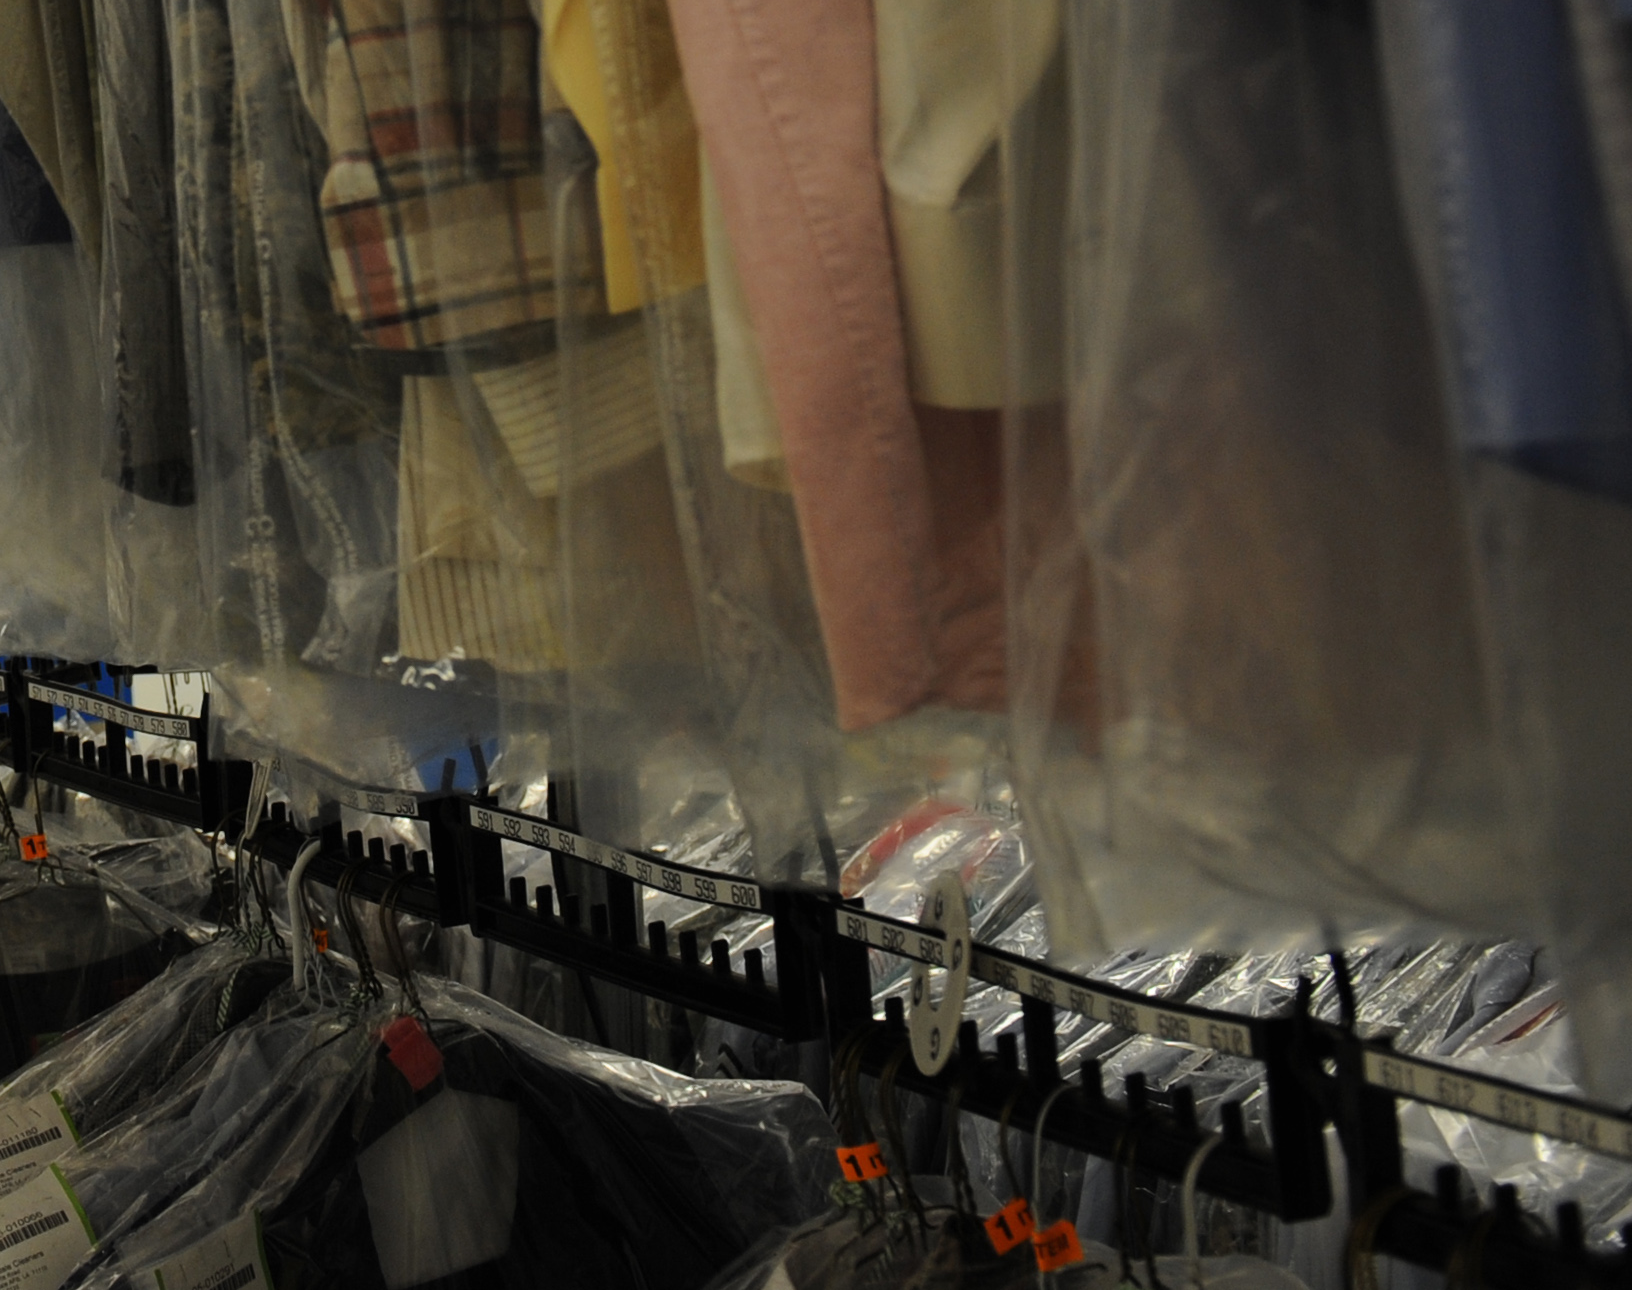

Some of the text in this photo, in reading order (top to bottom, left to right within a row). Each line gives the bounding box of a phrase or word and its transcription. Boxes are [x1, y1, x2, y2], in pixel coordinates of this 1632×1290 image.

[47, 690, 58, 705] 572
[63, 694, 74, 709] 573
[150, 718, 166, 734] 579
[172, 721, 187, 736] 580
[26, 838, 37, 854] 1
[478, 811, 495, 832] 591
[503, 817, 521, 839] 592
[532, 824, 551, 847] 593
[558, 832, 576, 854] 594
[611, 852, 628, 874] 596
[636, 861, 653, 883] 597
[662, 869, 682, 893] 598
[694, 877, 717, 901] 599
[731, 885, 757, 907] 600
[846, 916, 869, 940] 601
[882, 929, 906, 954] 602
[919, 938, 944, 964] 603
[1070, 989, 1096, 1014] 607
[1156, 1013, 1191, 1042] 609
[1206, 1023, 1244, 1056] 610
[6, 1161, 37, 1176] Cleaners
[845, 1154, 864, 1178] 1
[995, 1215, 1014, 1241] 1
[12, 1251, 45, 1268] Cleaners
